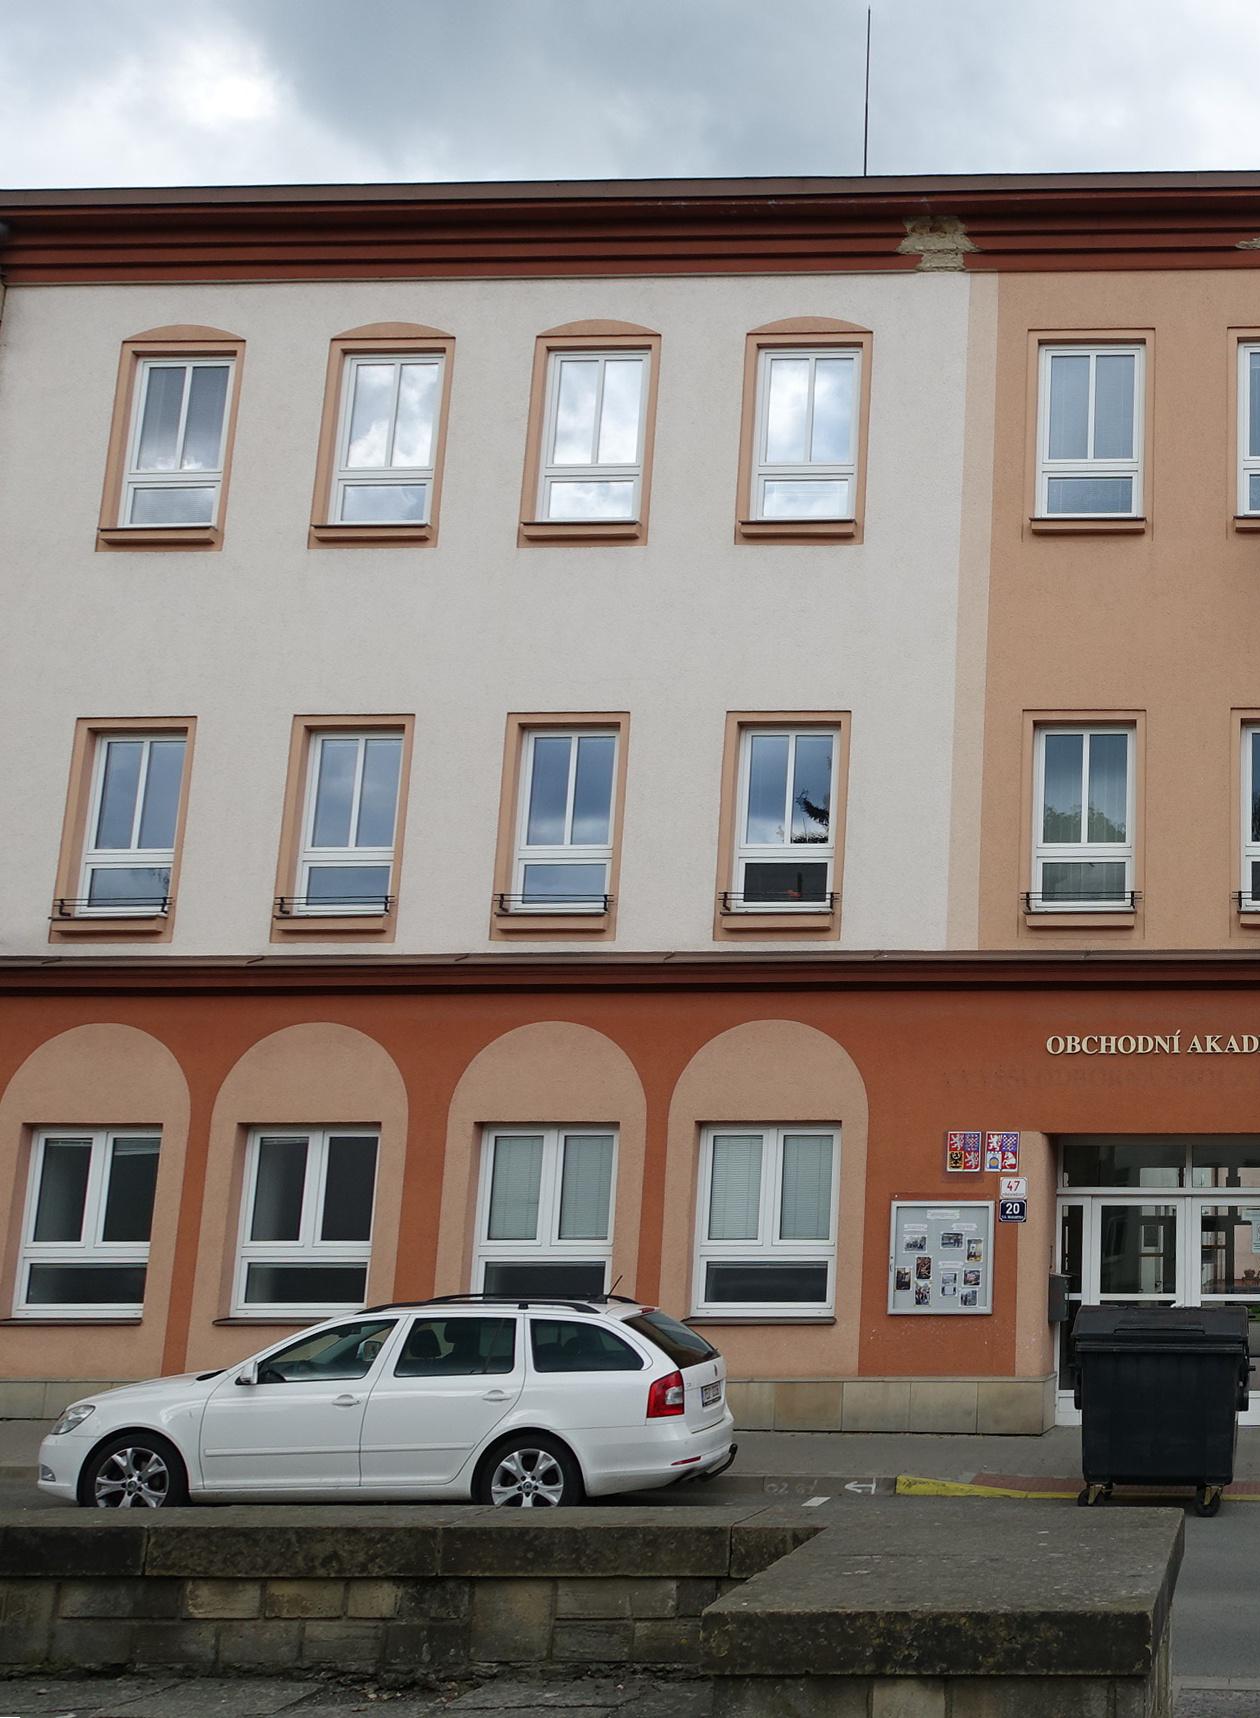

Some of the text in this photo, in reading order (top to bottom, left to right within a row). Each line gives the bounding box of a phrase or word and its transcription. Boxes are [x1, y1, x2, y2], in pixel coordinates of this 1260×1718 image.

[1046, 1030, 1181, 1055] OBCHODNÍ
[1007, 1180, 1020, 1191] 47
[1005, 1202, 1020, 1214] 20
